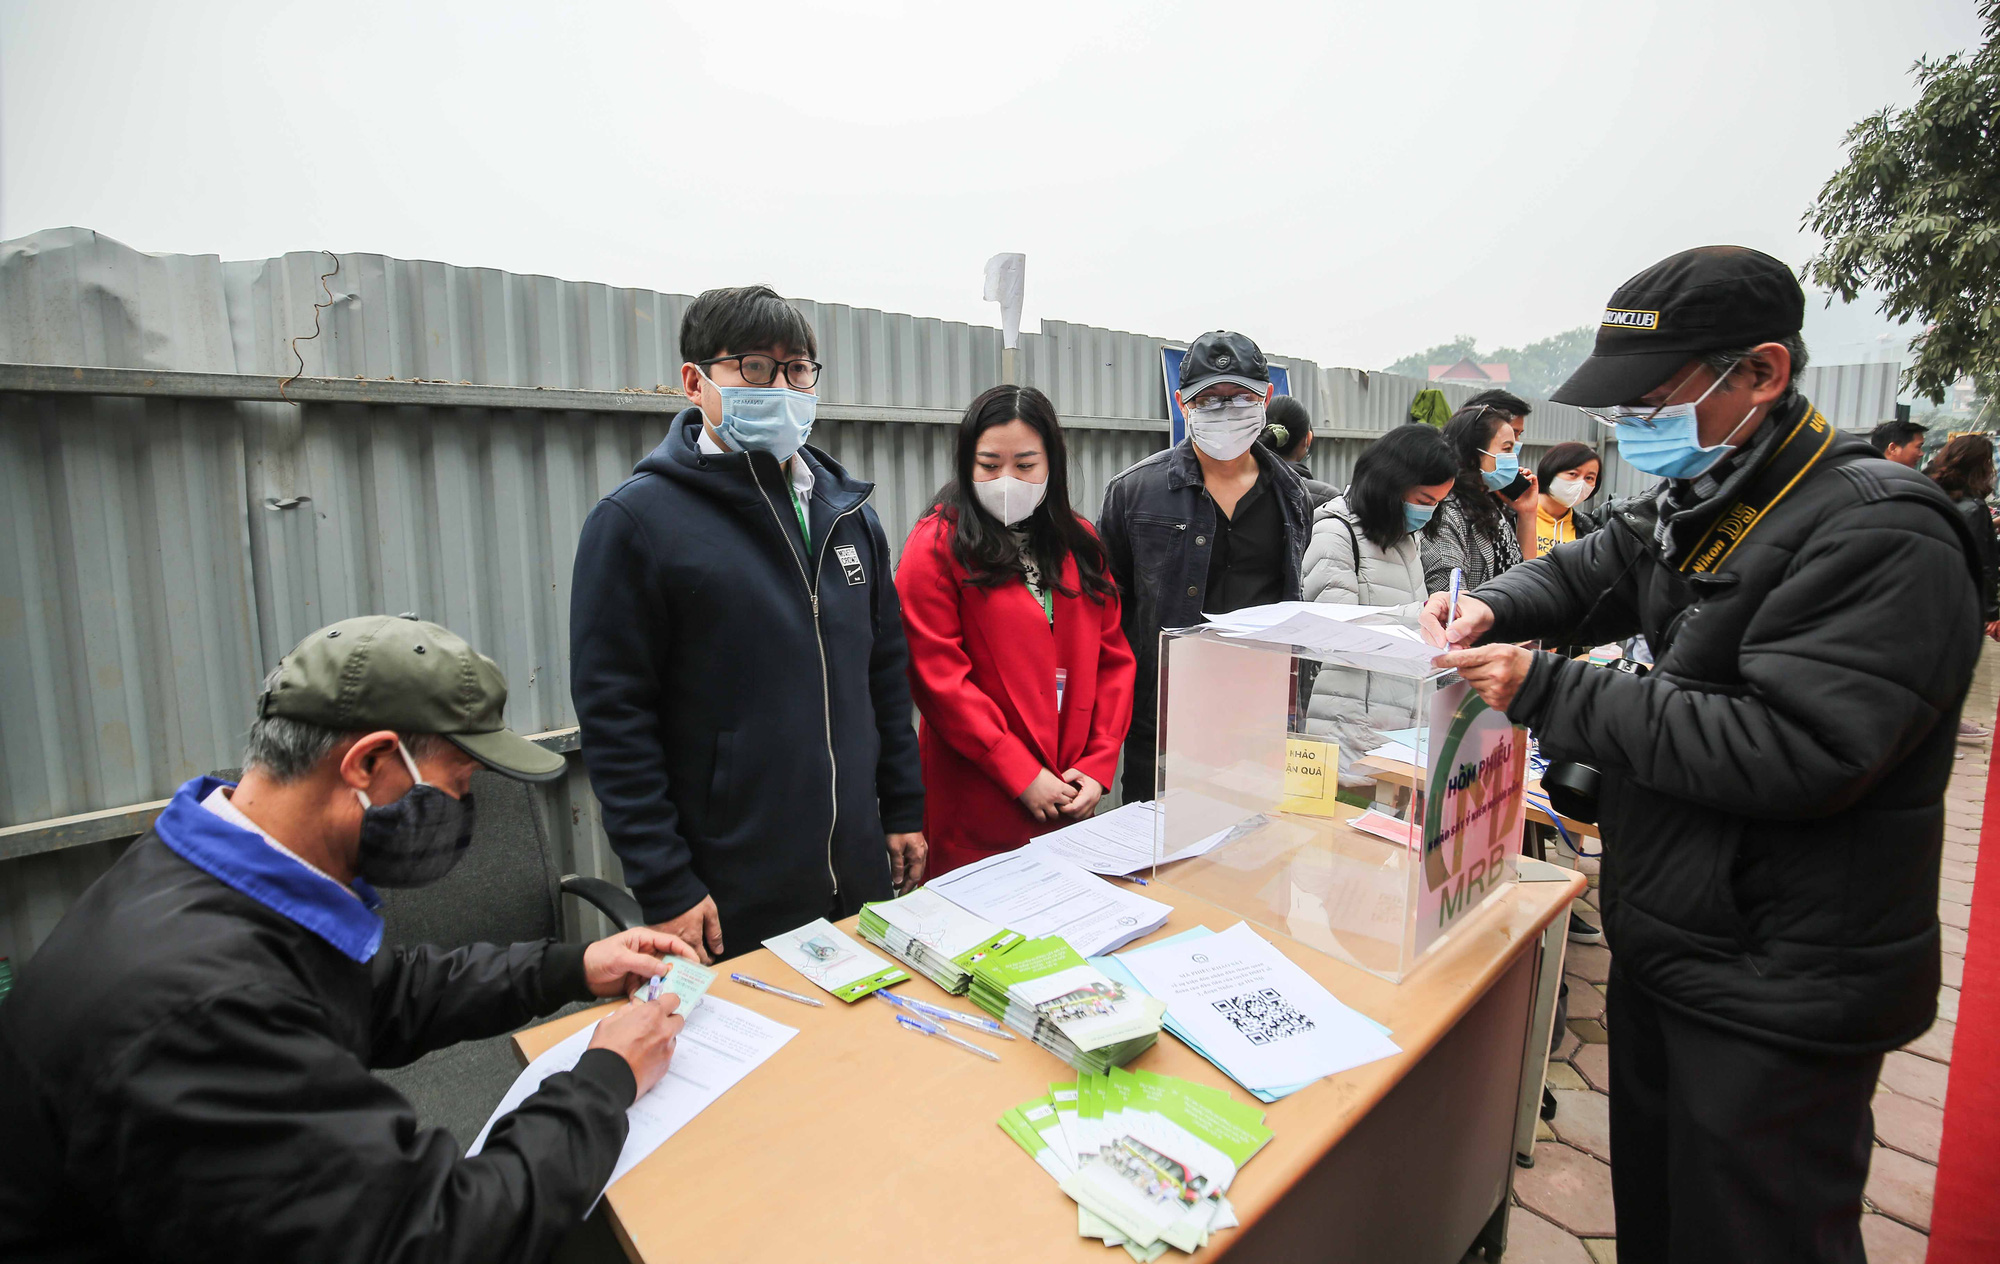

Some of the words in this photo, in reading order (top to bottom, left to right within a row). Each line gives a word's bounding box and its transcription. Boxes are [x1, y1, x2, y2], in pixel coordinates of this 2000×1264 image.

[1692, 539, 1726, 573] Nikon
[1300, 766, 1322, 776] QUẢ
[1447, 763, 1478, 799] HÒM
[1479, 735, 1511, 779] PHIẾU
[1439, 843, 1504, 928] MRB
